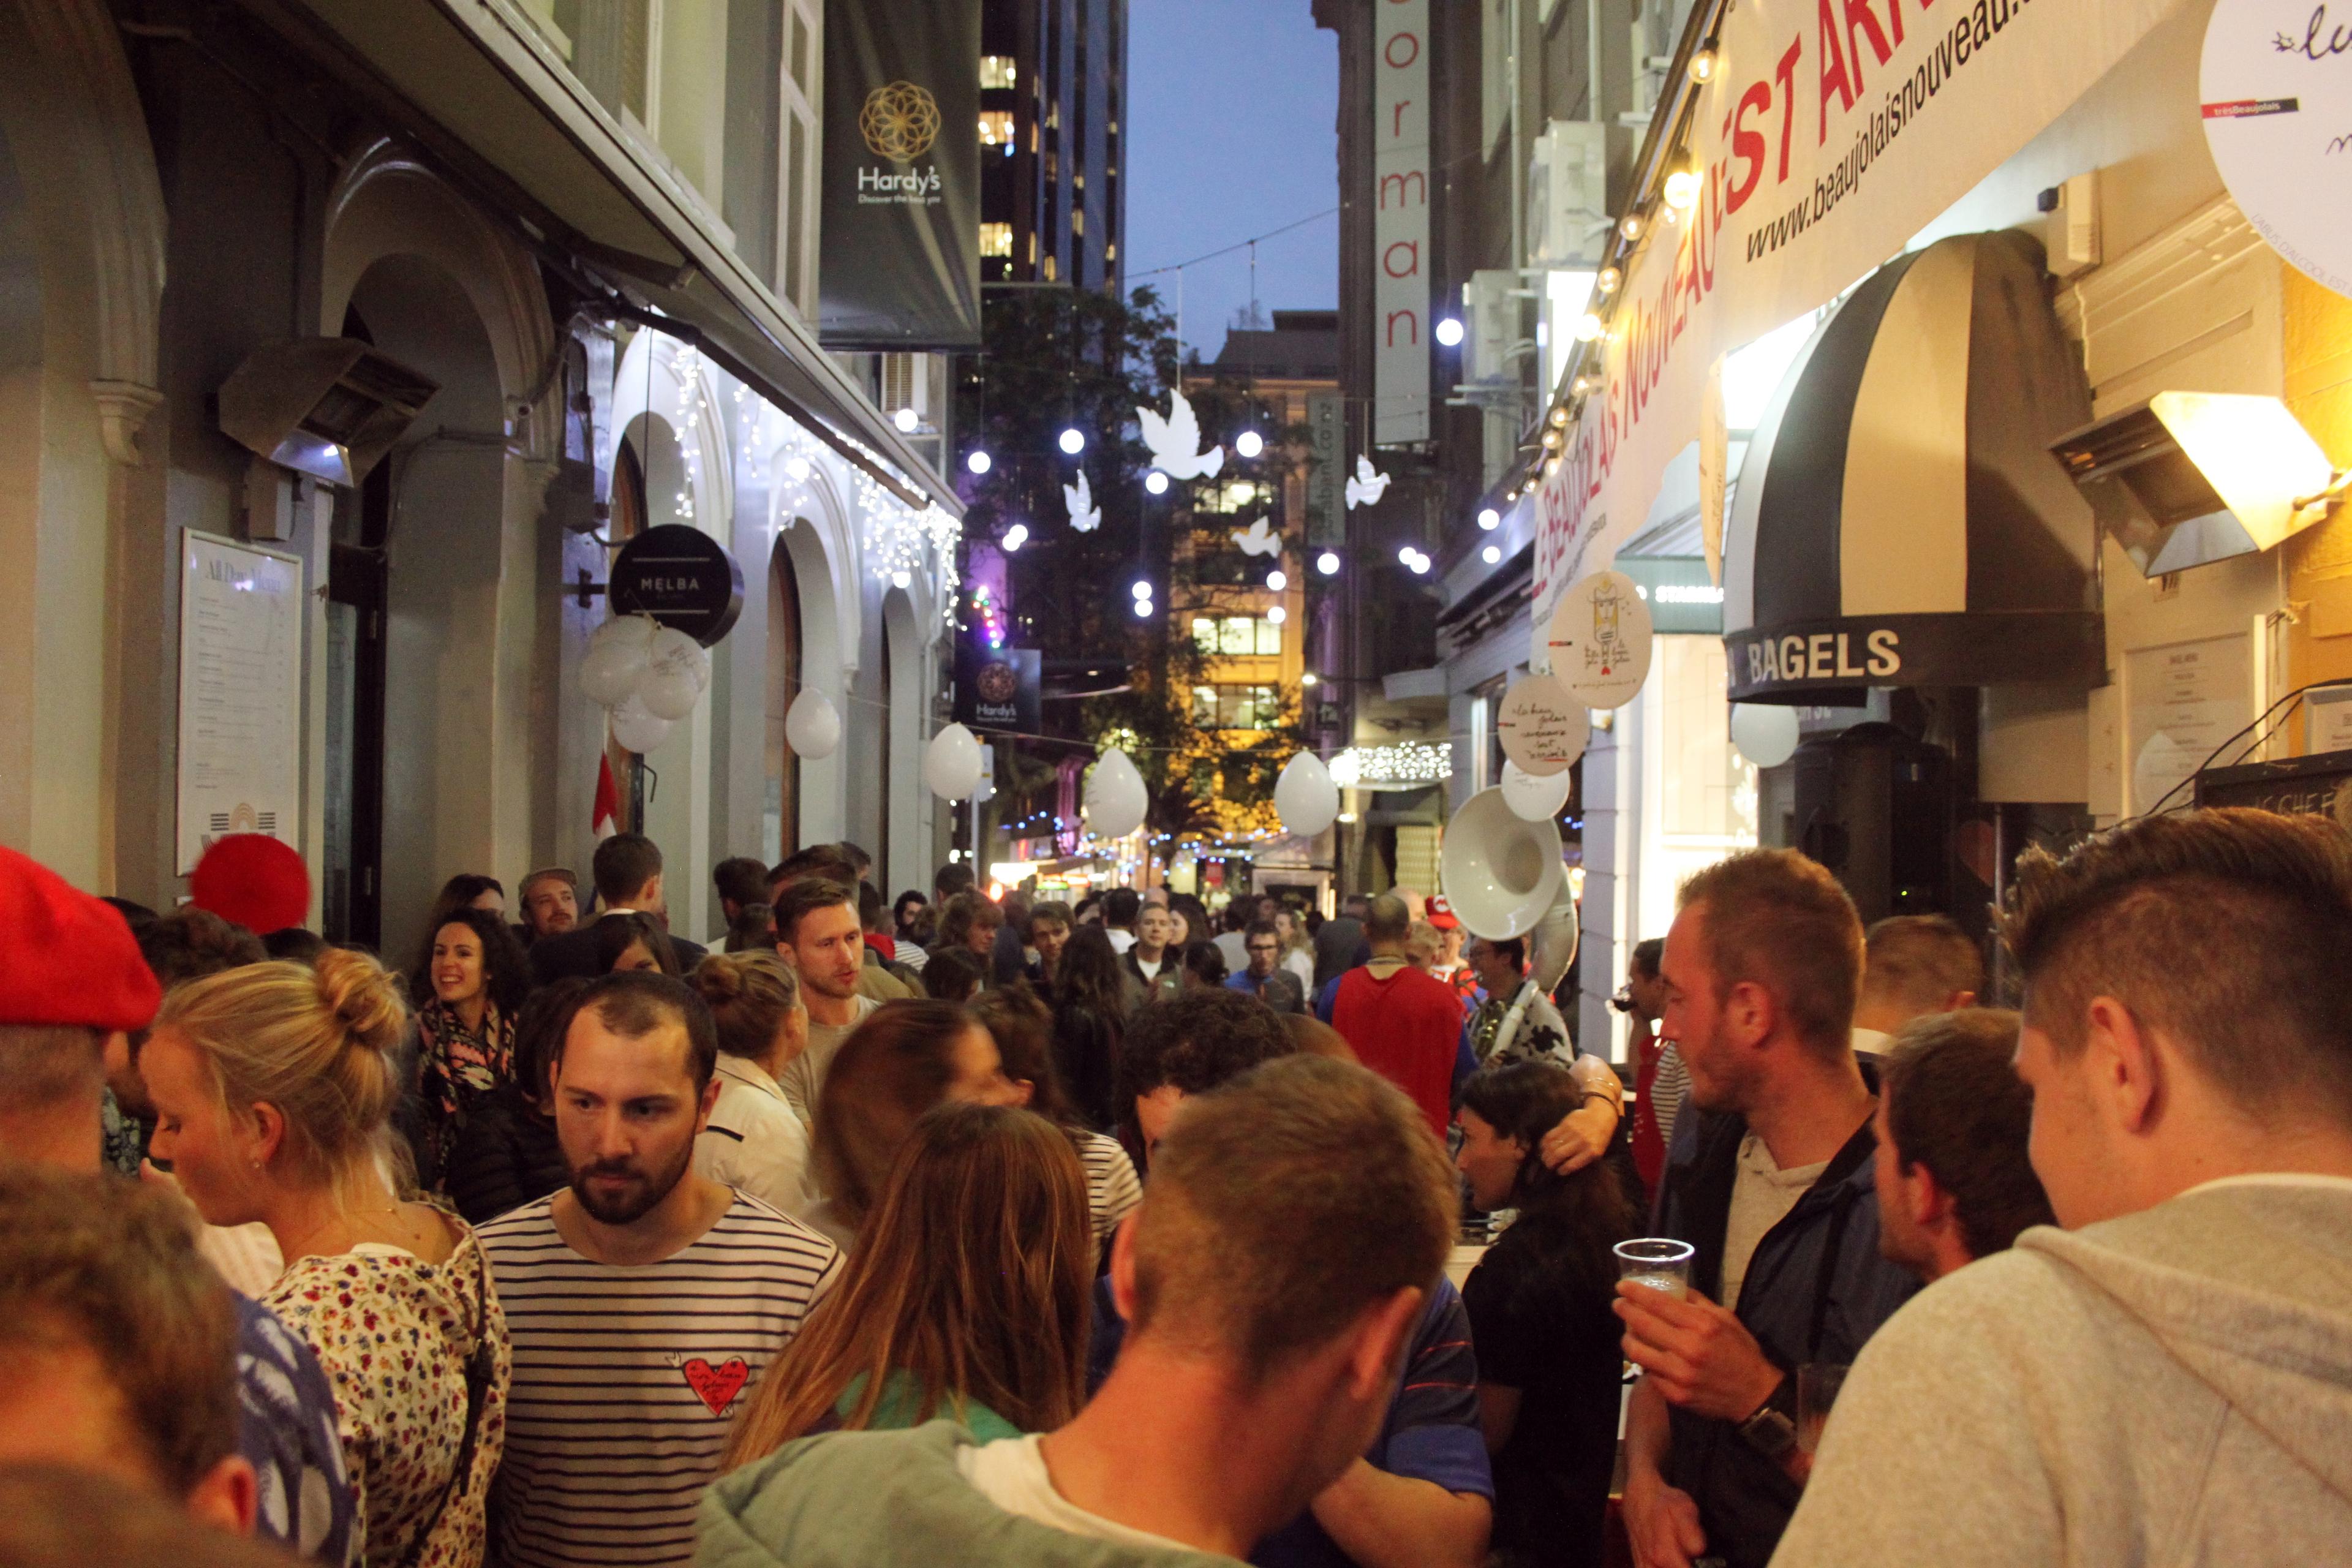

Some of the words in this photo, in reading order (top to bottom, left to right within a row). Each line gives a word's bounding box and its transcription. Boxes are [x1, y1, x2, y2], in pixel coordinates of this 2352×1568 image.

[858, 165, 941, 196] Hardy's
[1380, 0, 1425, 348] orman
[641, 577, 699, 591] MELBA
[1747, 629, 1901, 685] BAGELS
[976, 703, 1016, 718] Hardy's
